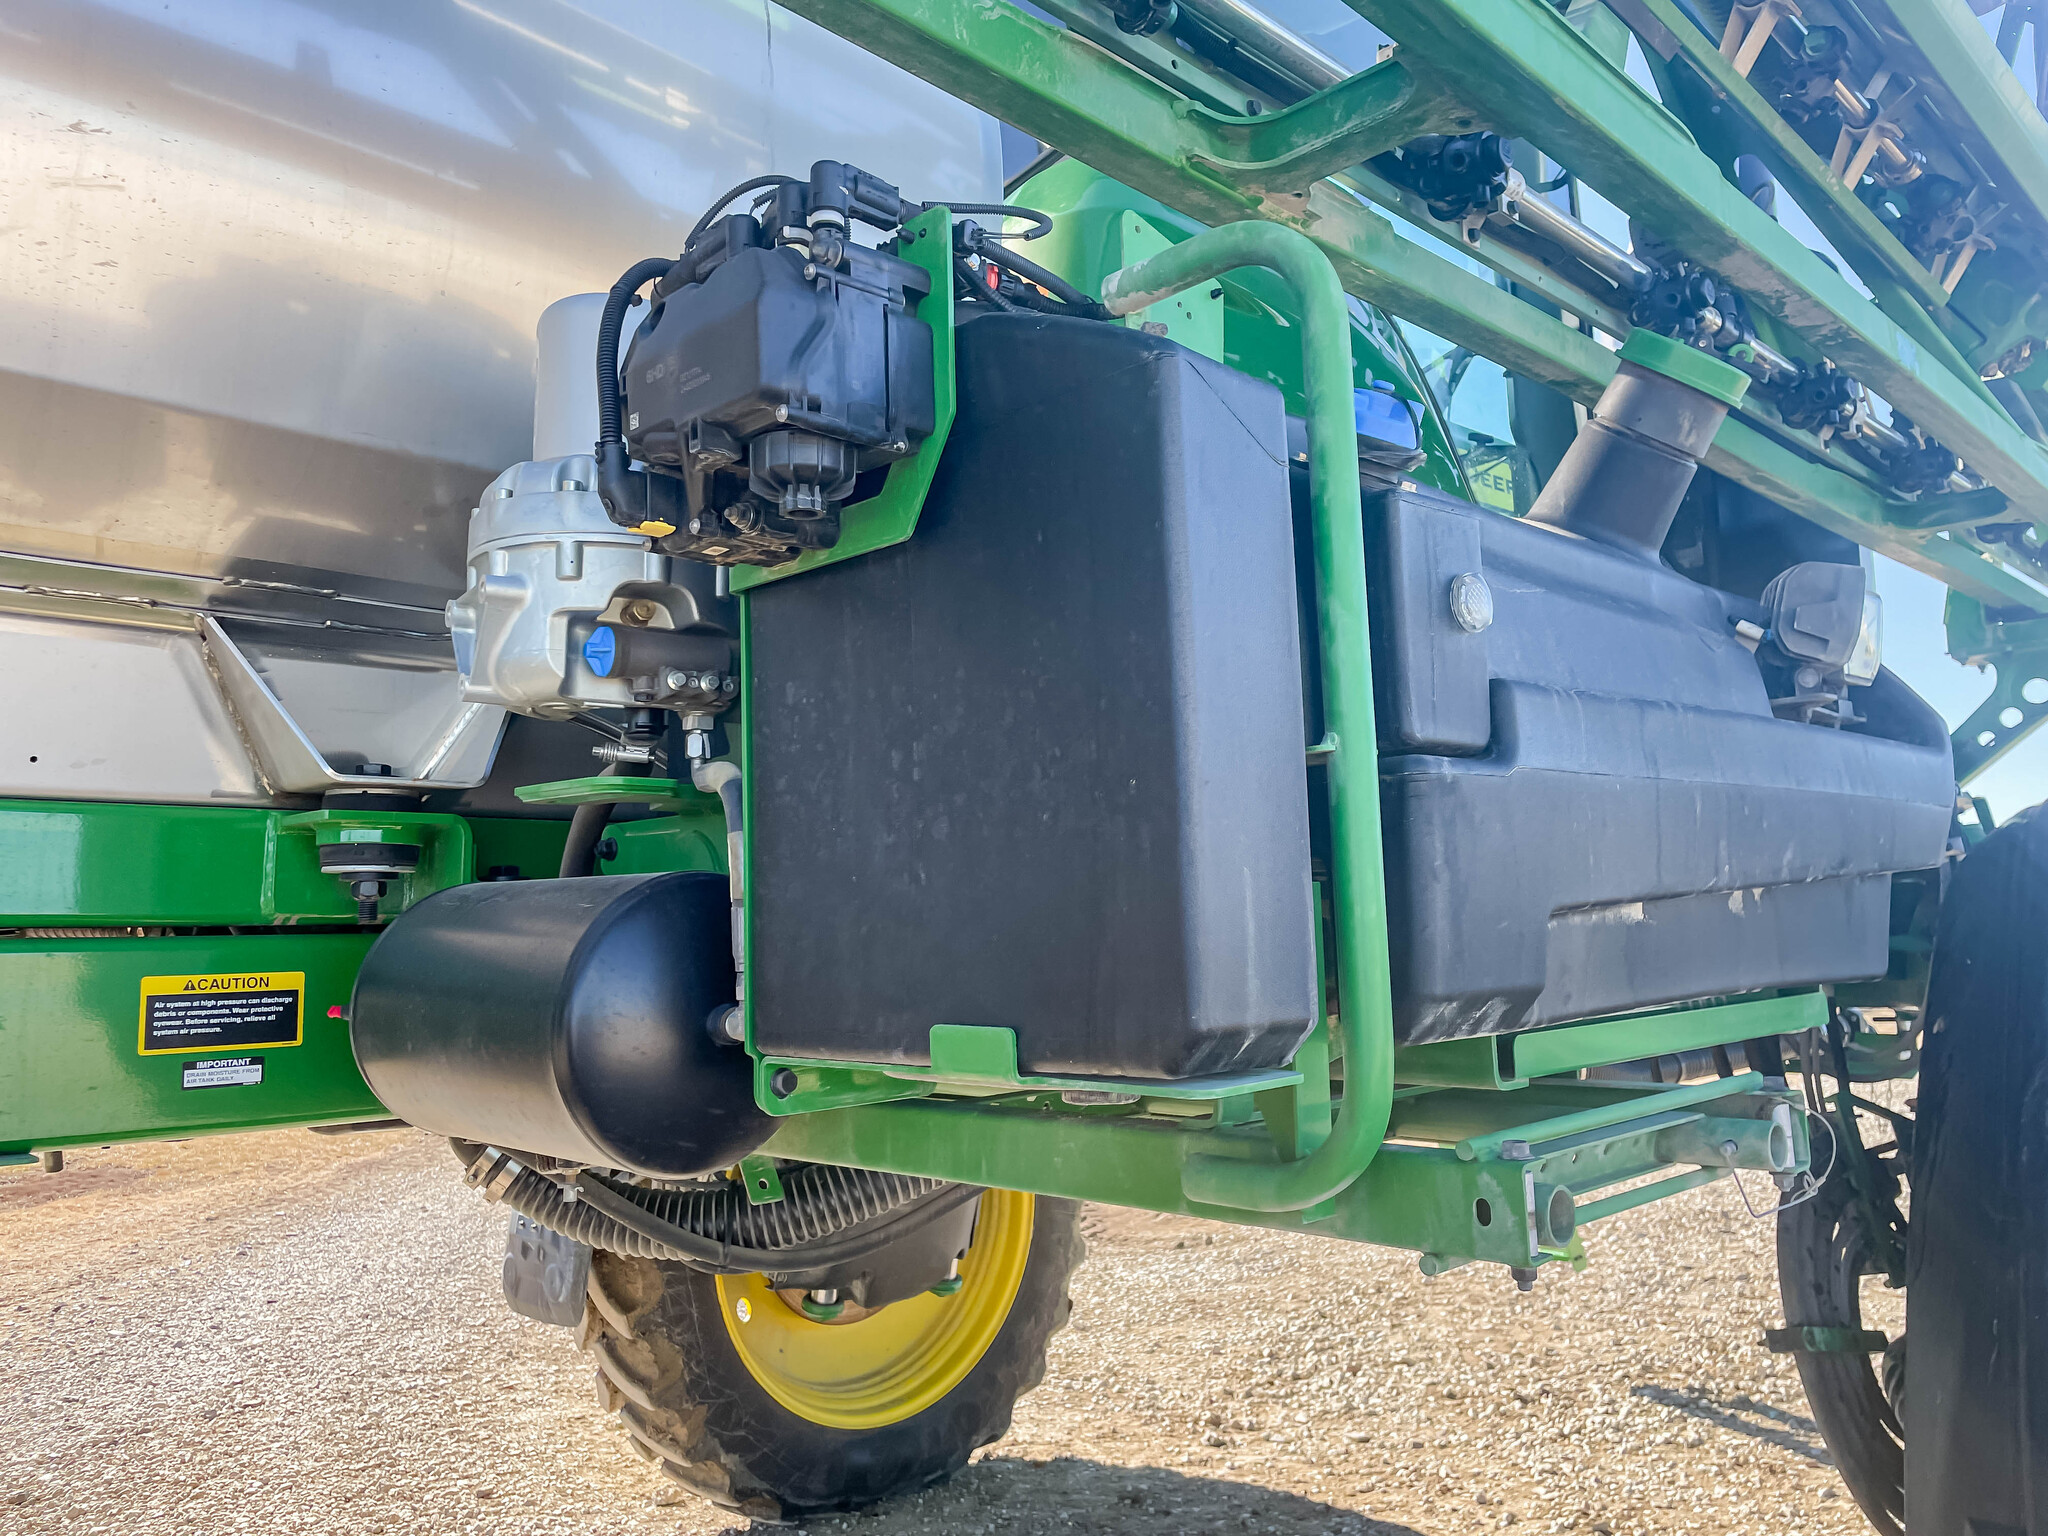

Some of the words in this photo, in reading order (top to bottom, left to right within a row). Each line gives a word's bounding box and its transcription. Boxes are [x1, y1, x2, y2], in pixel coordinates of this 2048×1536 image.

[198, 977, 269, 991] CAUTION
[166, 1001, 191, 1009] system
[187, 1008, 231, 1016] components.
[190, 1027, 222, 1035] pressure.
[197, 1058, 251, 1069] IMPORTANT
